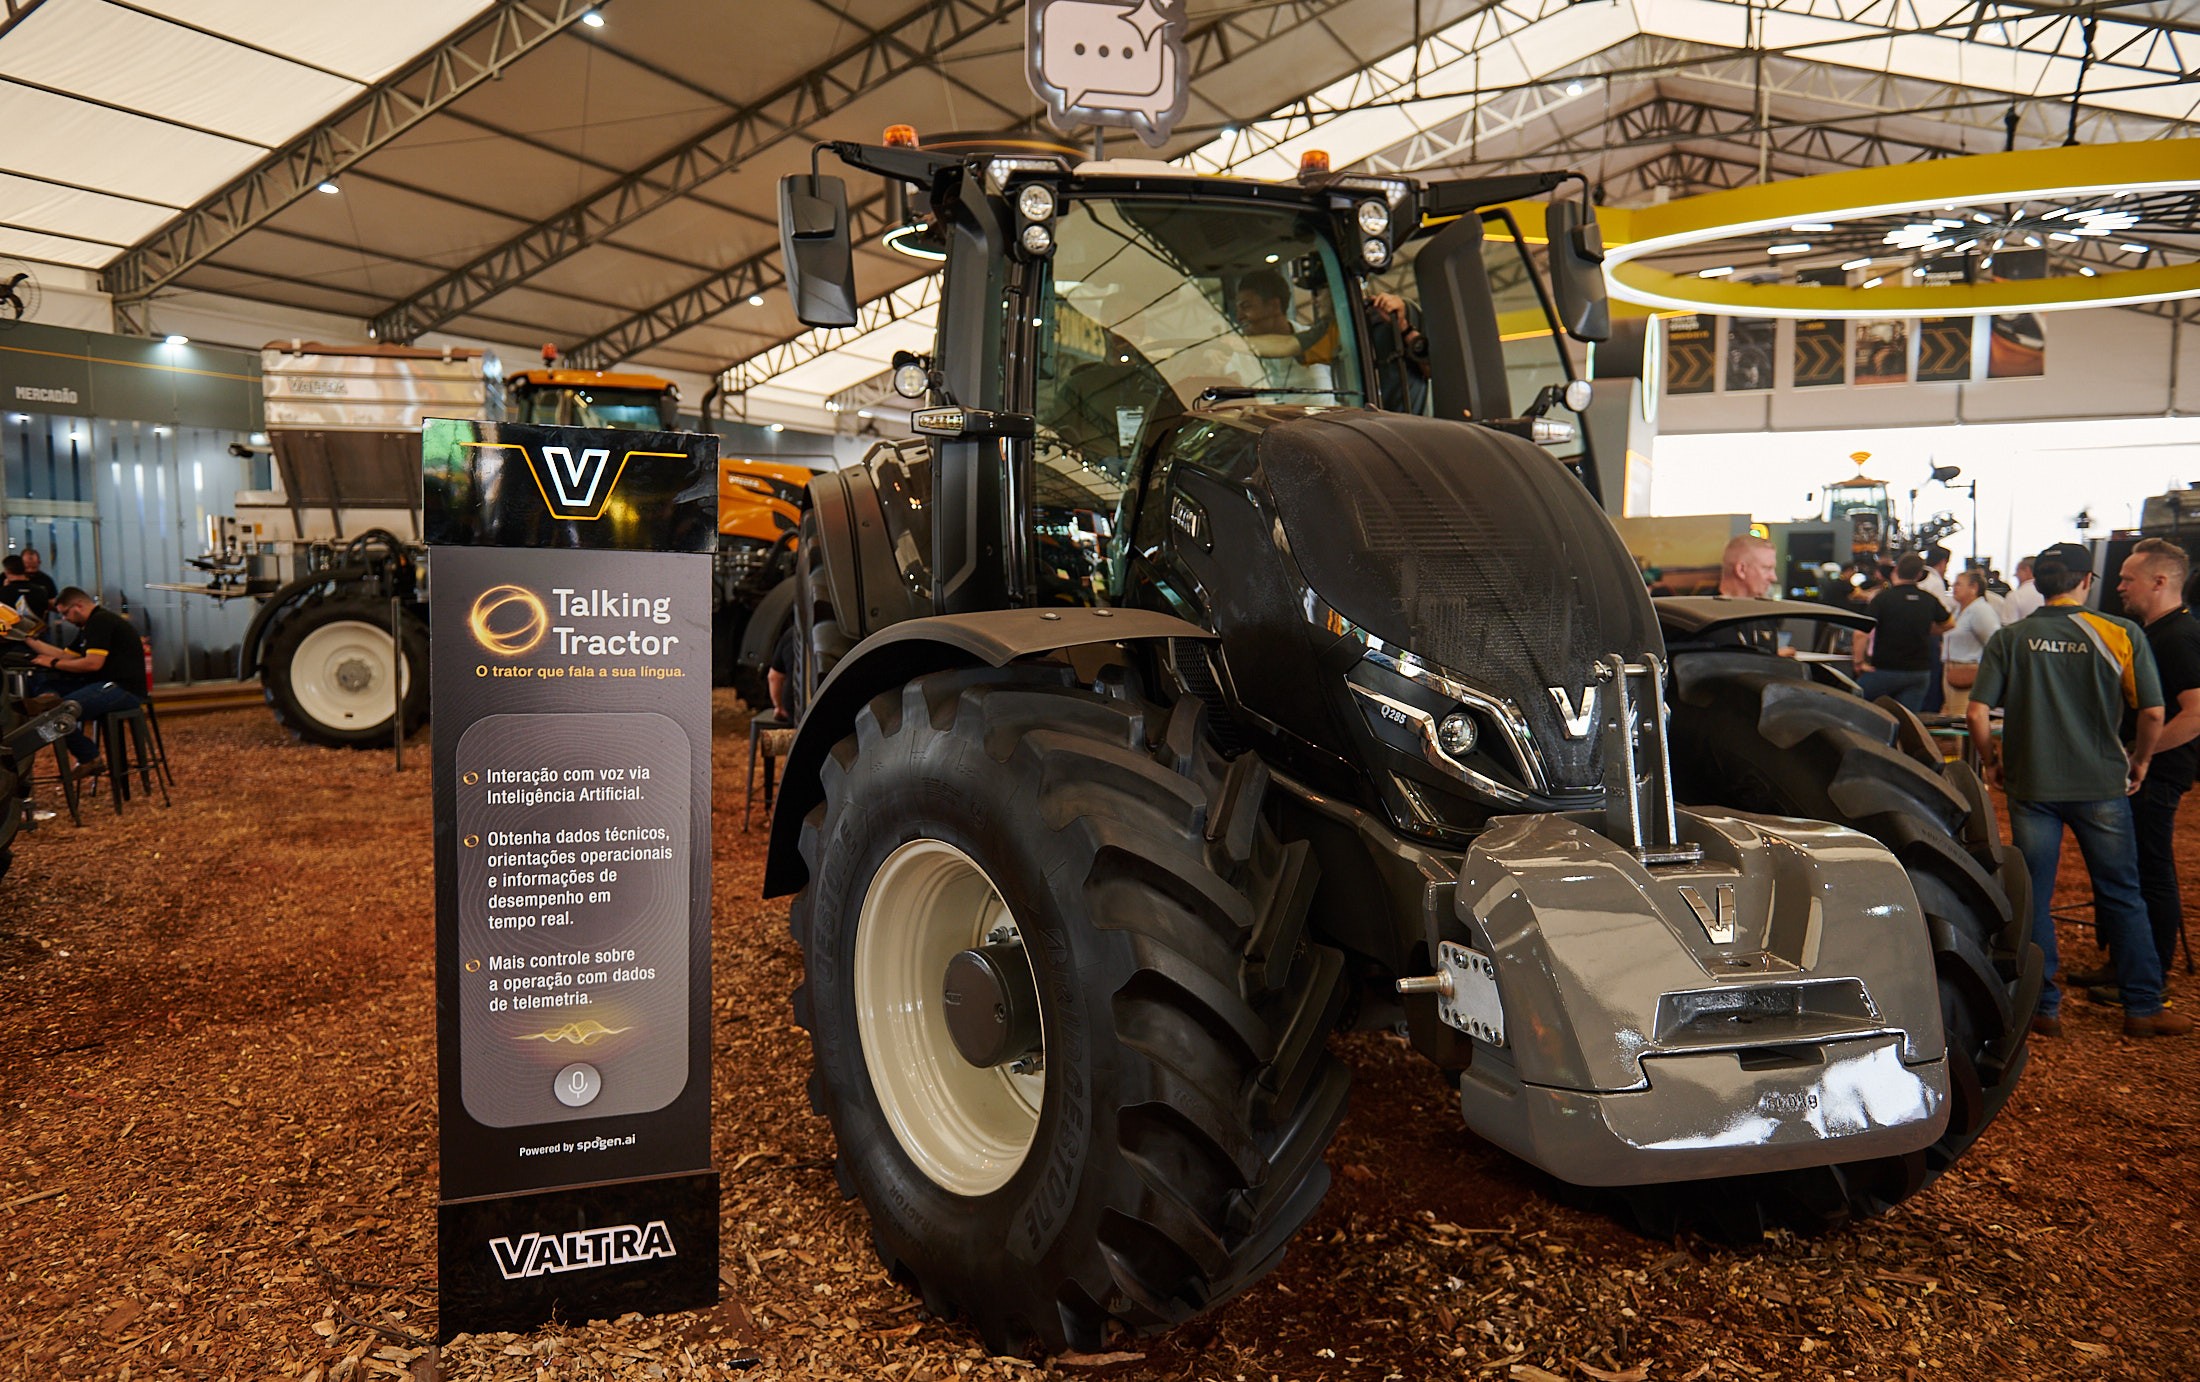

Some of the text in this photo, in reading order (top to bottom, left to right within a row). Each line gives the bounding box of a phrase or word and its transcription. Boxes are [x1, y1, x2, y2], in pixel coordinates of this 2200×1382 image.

[15, 386, 78, 404] MERCADÃO
[541, 446, 610, 507] V
[552, 588, 671, 625] Talking
[552, 626, 679, 656] Tractor
[2028, 638, 2088, 654] VALTRA
[475, 664, 686, 680] O trator que fala a sua língua.
[1381, 704, 1407, 724] Q285
[487, 765, 650, 786] Interação com voz via
[487, 786, 645, 807] Inteligência Artificial.
[487, 826, 670, 847] Obtenha dados técnicos,
[487, 846, 673, 868] orientações operacionais
[488, 868, 618, 888] e informações de
[488, 890, 611, 909] desempenho em
[488, 911, 574, 931] tempo real.
[489, 948, 636, 971] Mais controle sobre
[489, 966, 656, 992] a operação com dados
[489, 991, 593, 1012] de telemetria.
[519, 1134, 636, 1157] Powered by spogen.ai
[488, 1220, 677, 1280] VALTRA
